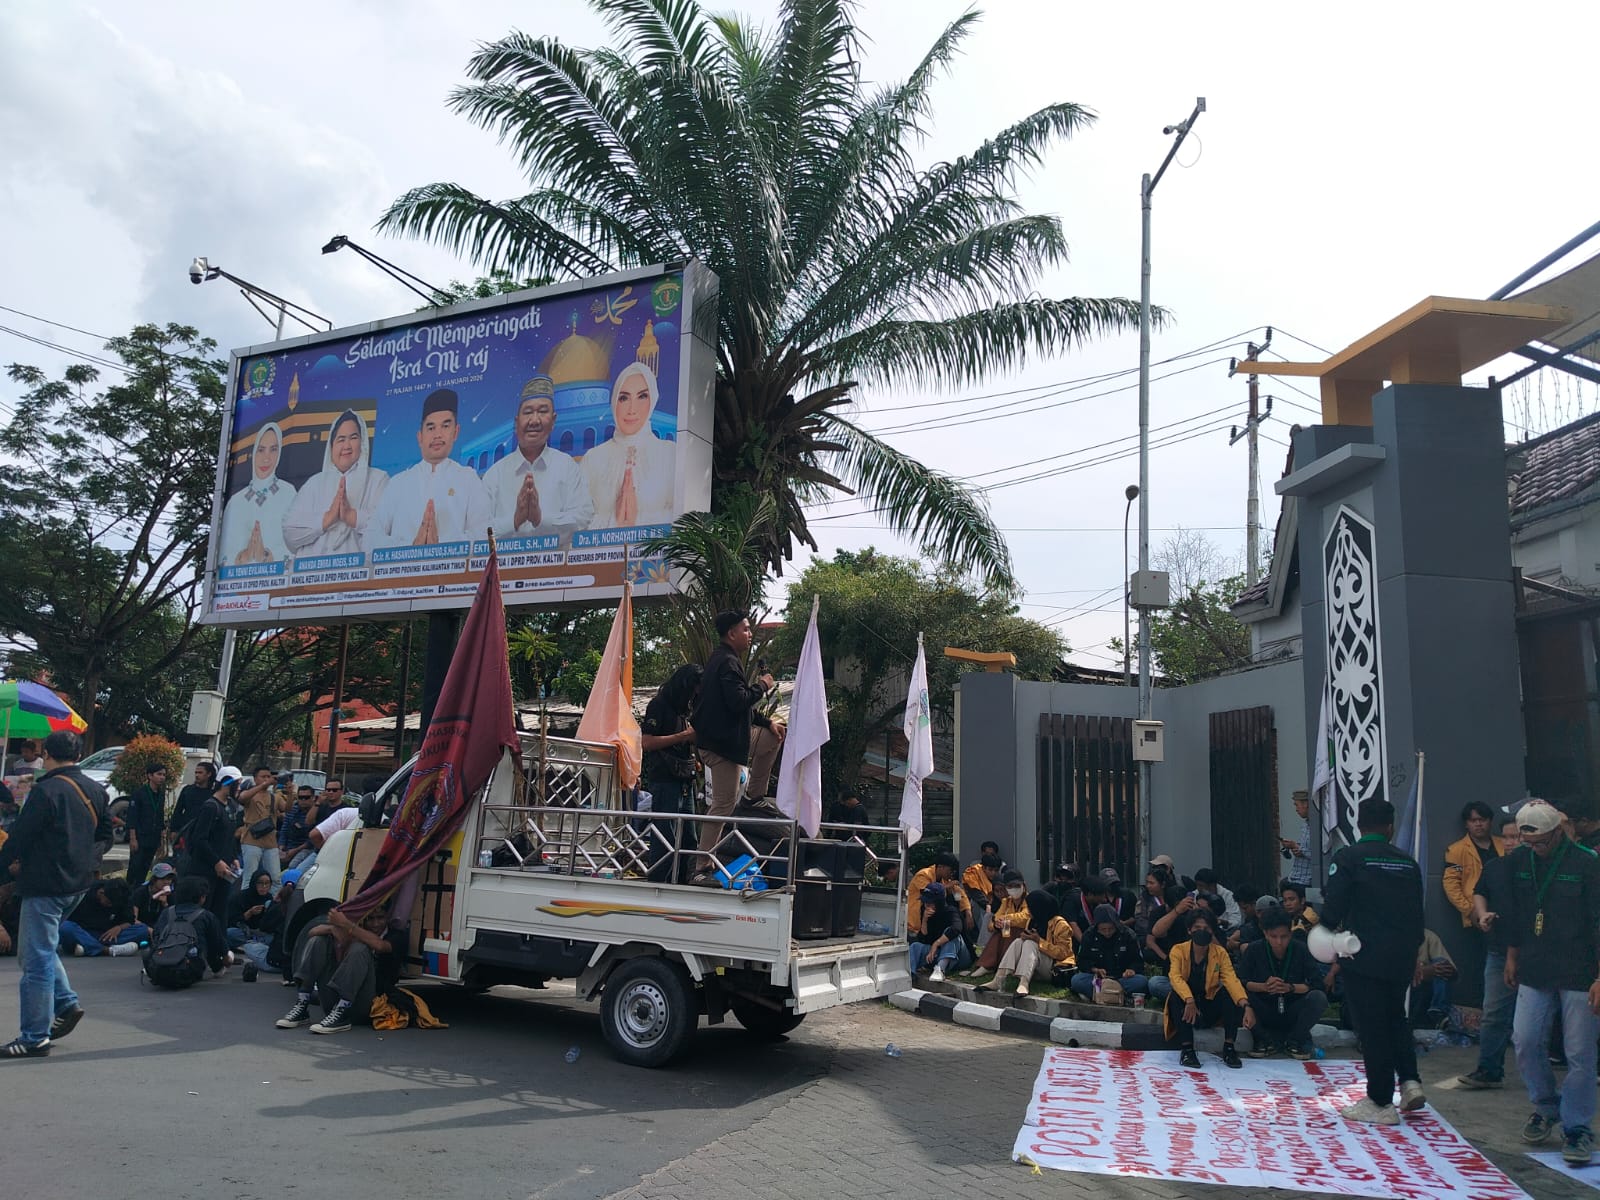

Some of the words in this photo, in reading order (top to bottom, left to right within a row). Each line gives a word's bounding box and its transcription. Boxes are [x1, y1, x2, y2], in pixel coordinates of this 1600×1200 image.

[389, 356, 424, 384] Isra
[442, 376, 469, 387] JANUARI
[543, 537, 558, 548] M.M
[601, 530, 637, 543] NORHAYATI
[391, 549, 423, 561] HASANUDDIN
[511, 556, 526, 566] DPRD
[526, 555, 542, 565] PROV.
[543, 553, 564, 564] KALTIM
[568, 552, 595, 563] SEKRETARIS
[595, 551, 608, 560] DPRD
[374, 567, 389, 576] KETUA
[389, 566, 400, 575] DPRD
[421, 563, 449, 572] KALIMANTAN
[449, 561, 466, 570] TIMUR
[324, 573, 337, 582] DPRD
[350, 570, 368, 580] KALTIM
[420, 740, 450, 760] UKUM
[1030, 1106, 1108, 1158] POIN
